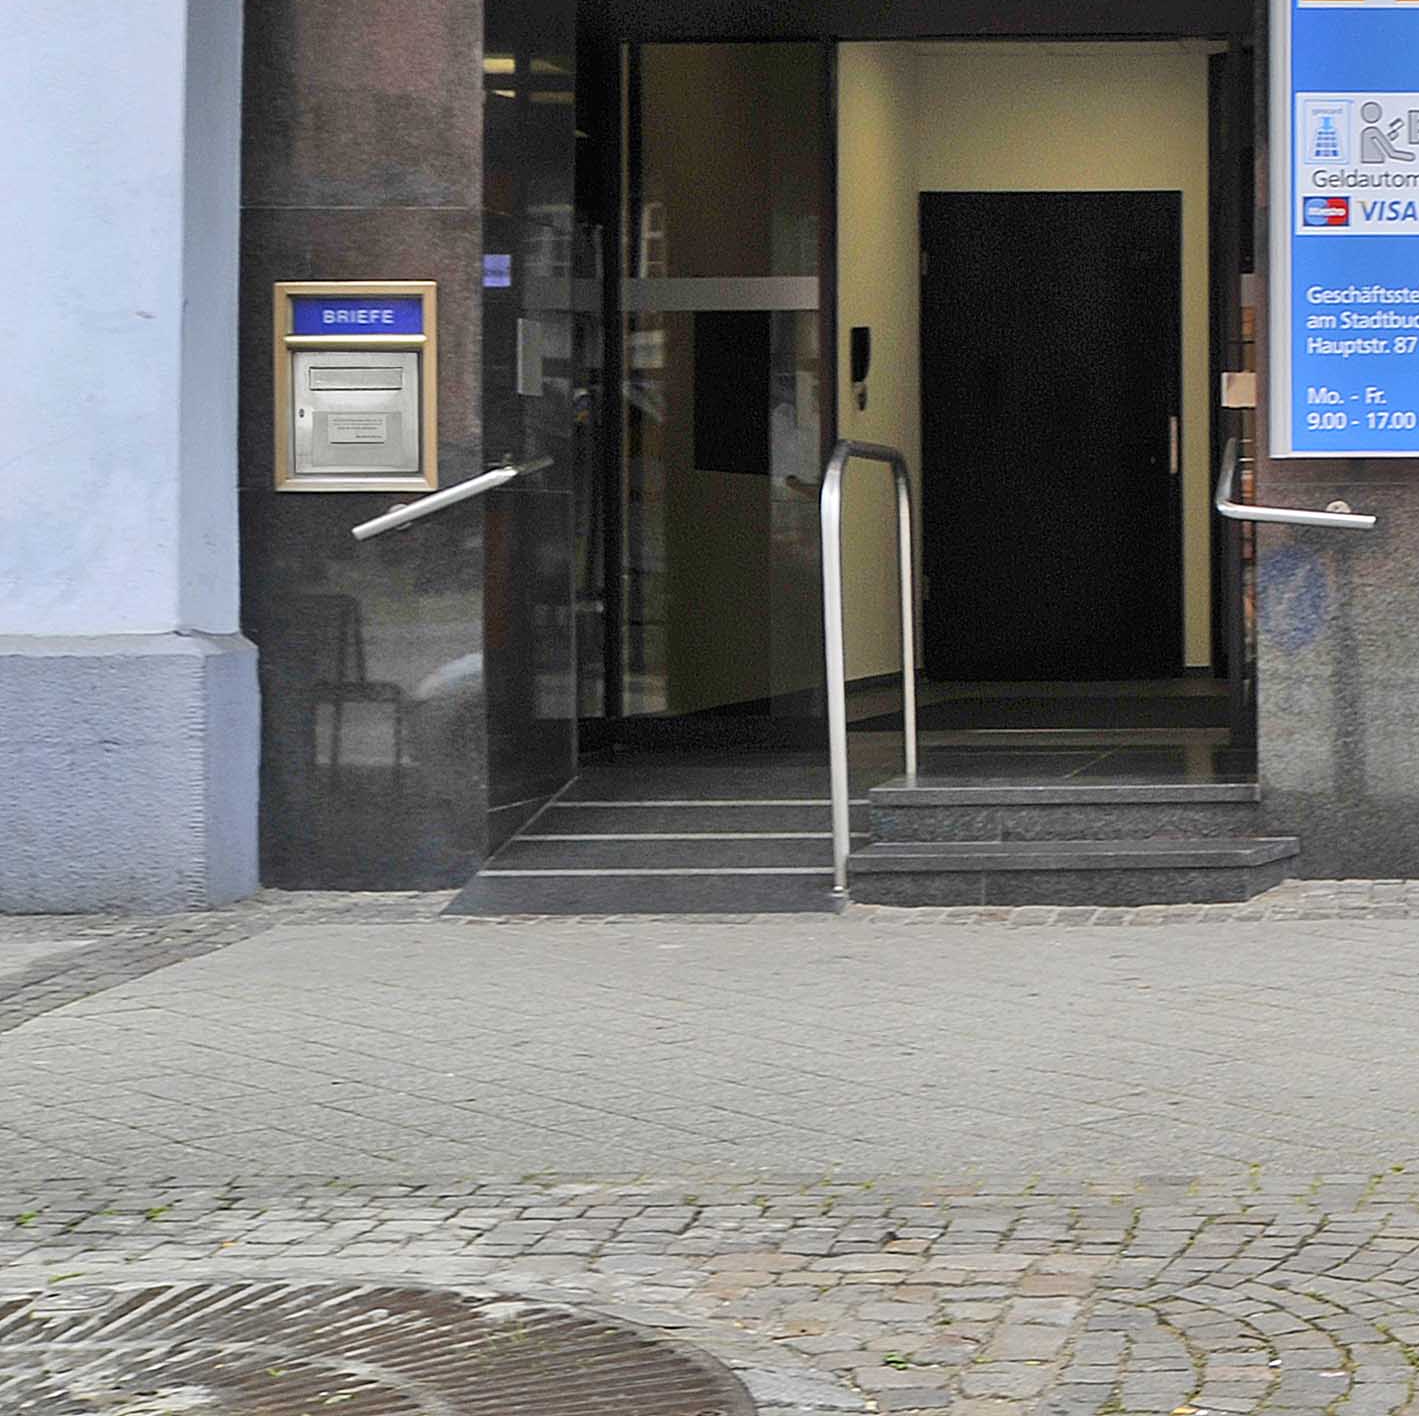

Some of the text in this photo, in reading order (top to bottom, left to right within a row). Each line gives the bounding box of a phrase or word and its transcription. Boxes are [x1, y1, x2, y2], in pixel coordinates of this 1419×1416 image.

[1357, 200, 1418, 221] VISA
[323, 309, 395, 324] BRIEFE
[1306, 315, 1336, 329] am
[1306, 337, 1418, 358] Hauptstr. 87
[1307, 387, 1345, 405] Mo.
[1365, 387, 1388, 405] Fr.
[1306, 412, 1347, 430] 9.00
[1367, 412, 1417, 429] 17.00
